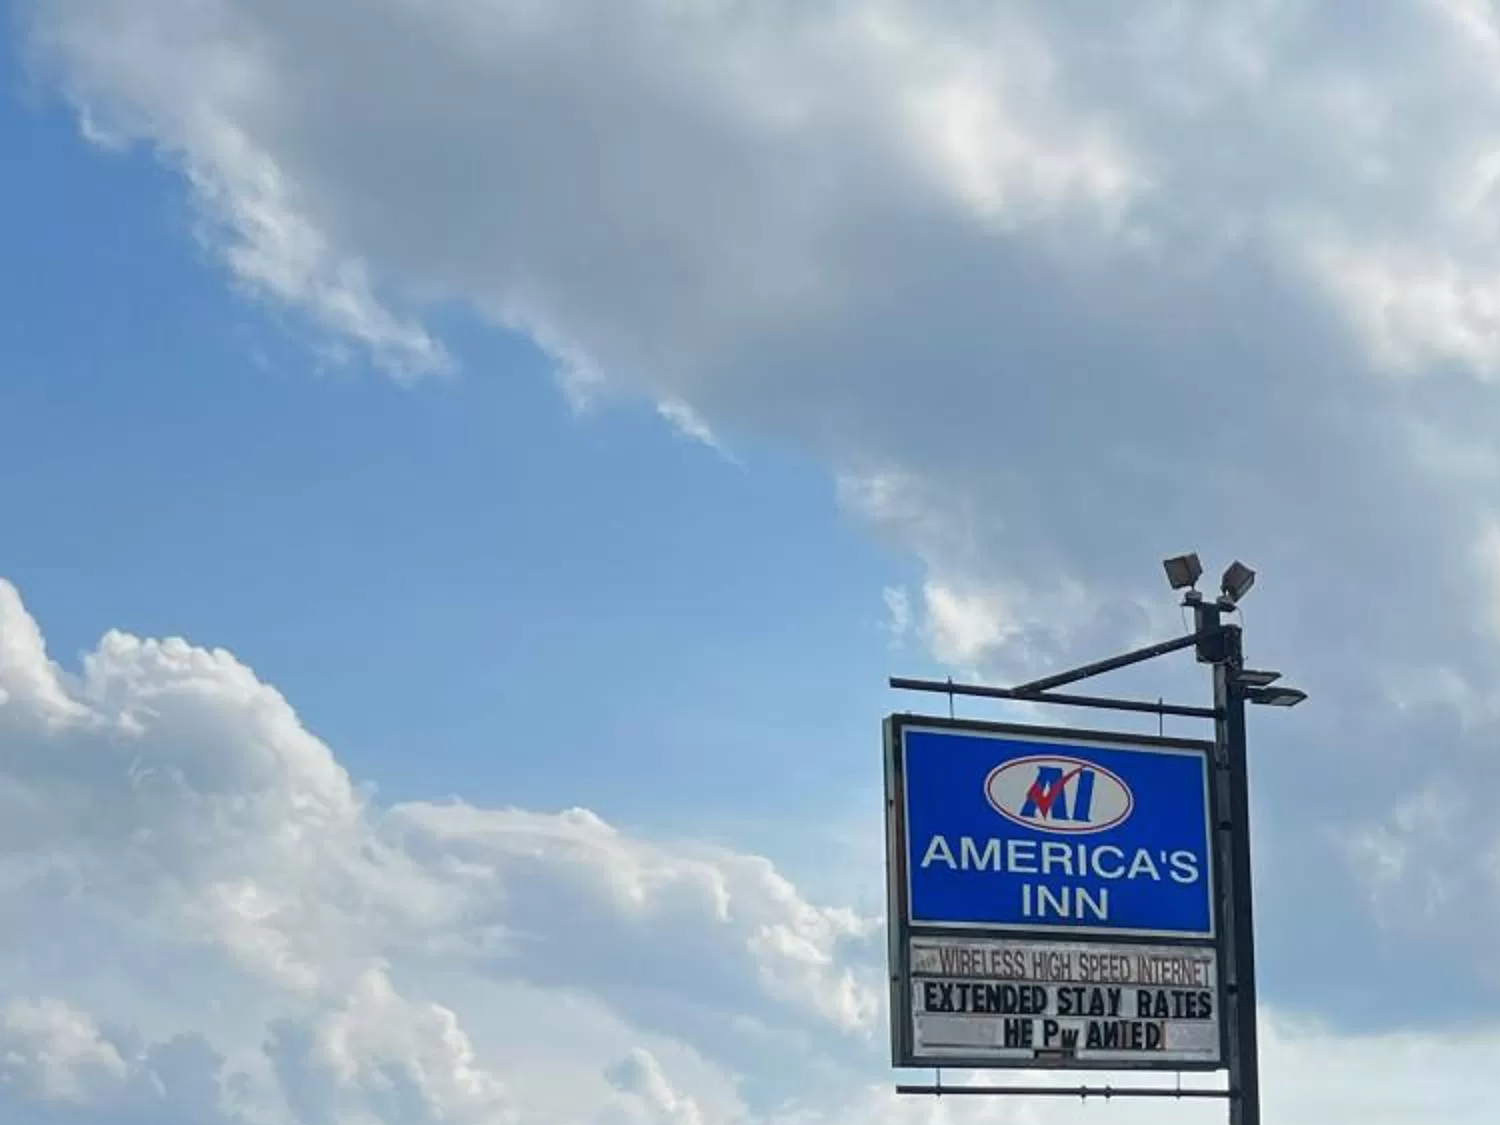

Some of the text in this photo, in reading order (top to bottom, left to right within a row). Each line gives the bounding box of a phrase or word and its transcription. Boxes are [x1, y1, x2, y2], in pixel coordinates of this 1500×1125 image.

[921, 835, 1199, 884] AMERICA'S
[1022, 884, 1109, 920] INN
[939, 946, 1025, 979] WIRELESS
[1032, 950, 1071, 981] HIGH
[1079, 952, 1132, 982] SPEED
[1138, 955, 1212, 988] INTERNET
[924, 980, 1212, 1020] EXTENDED STAY RATES
